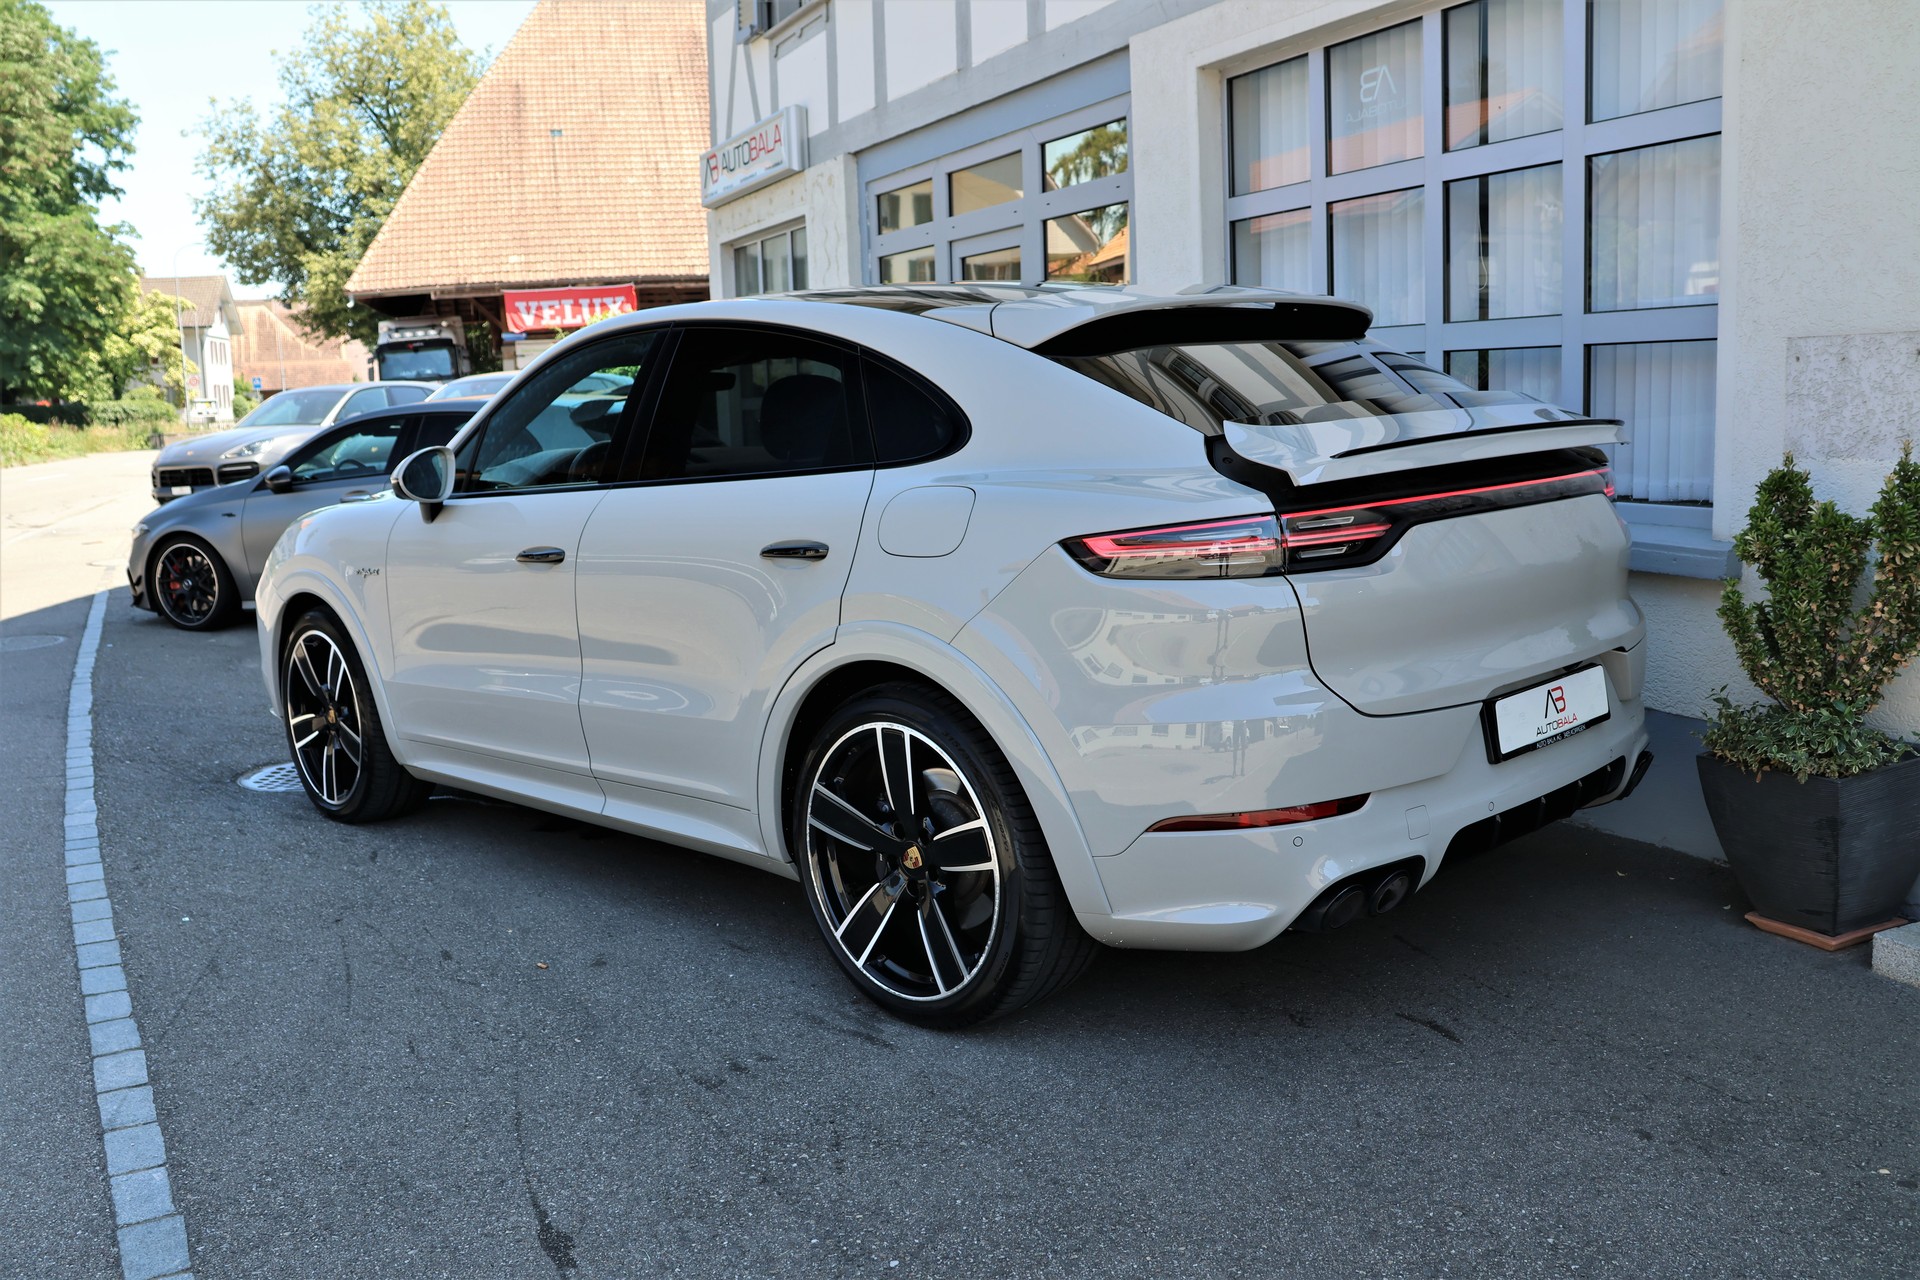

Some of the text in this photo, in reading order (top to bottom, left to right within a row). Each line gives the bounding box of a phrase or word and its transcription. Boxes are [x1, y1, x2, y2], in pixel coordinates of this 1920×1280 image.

[721, 124, 782, 175] AUTOBALA
[514, 295, 626, 327] VELUX
[1536, 712, 1578, 737] AUTOBALA
